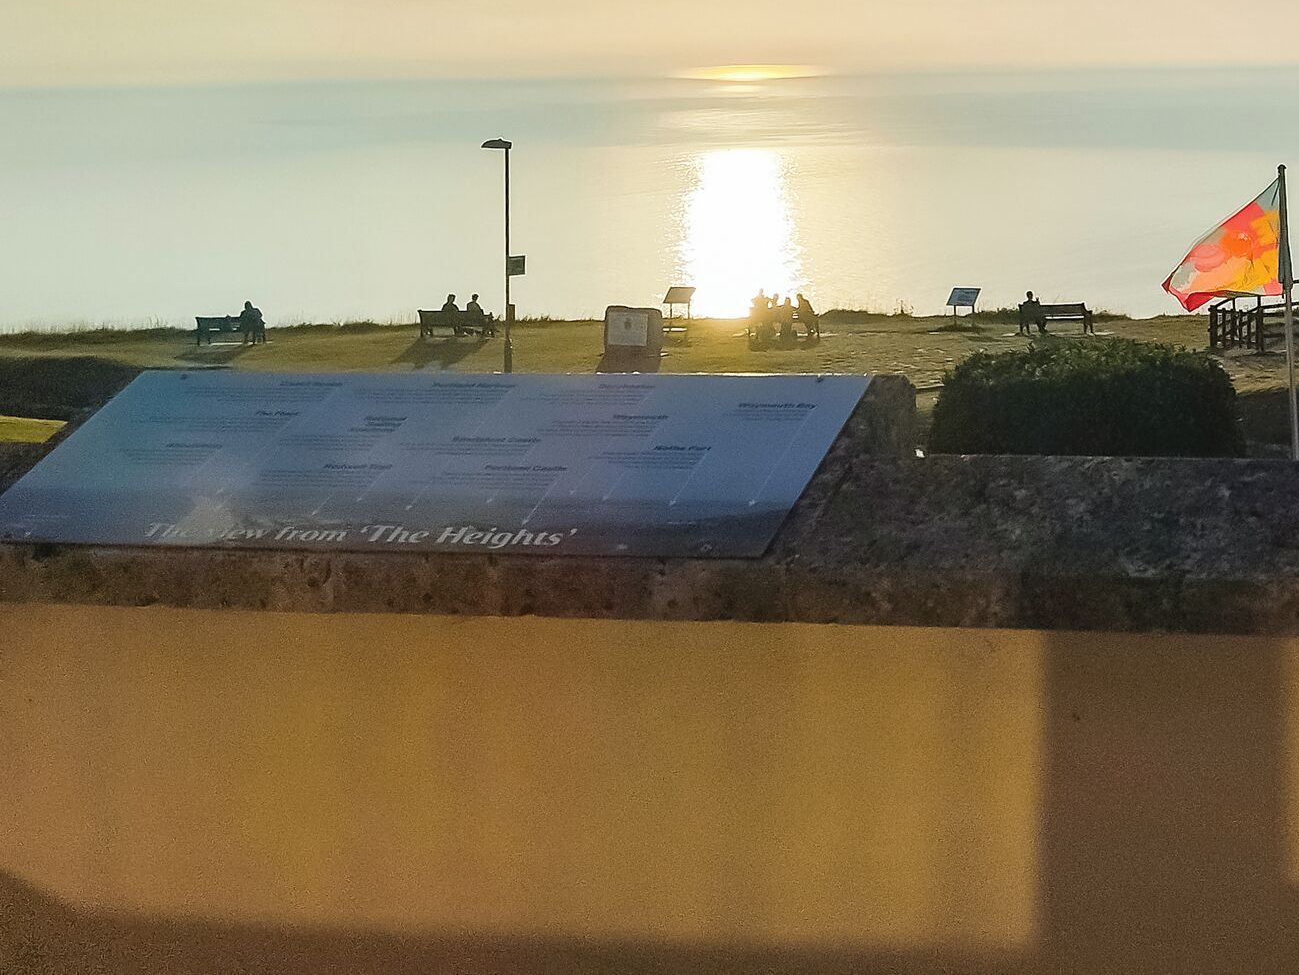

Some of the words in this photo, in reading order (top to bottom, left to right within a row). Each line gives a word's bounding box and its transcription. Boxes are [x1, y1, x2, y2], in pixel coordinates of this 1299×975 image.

[144, 522, 194, 538] The
[206, 526, 270, 539] view
[274, 525, 349, 542] from
